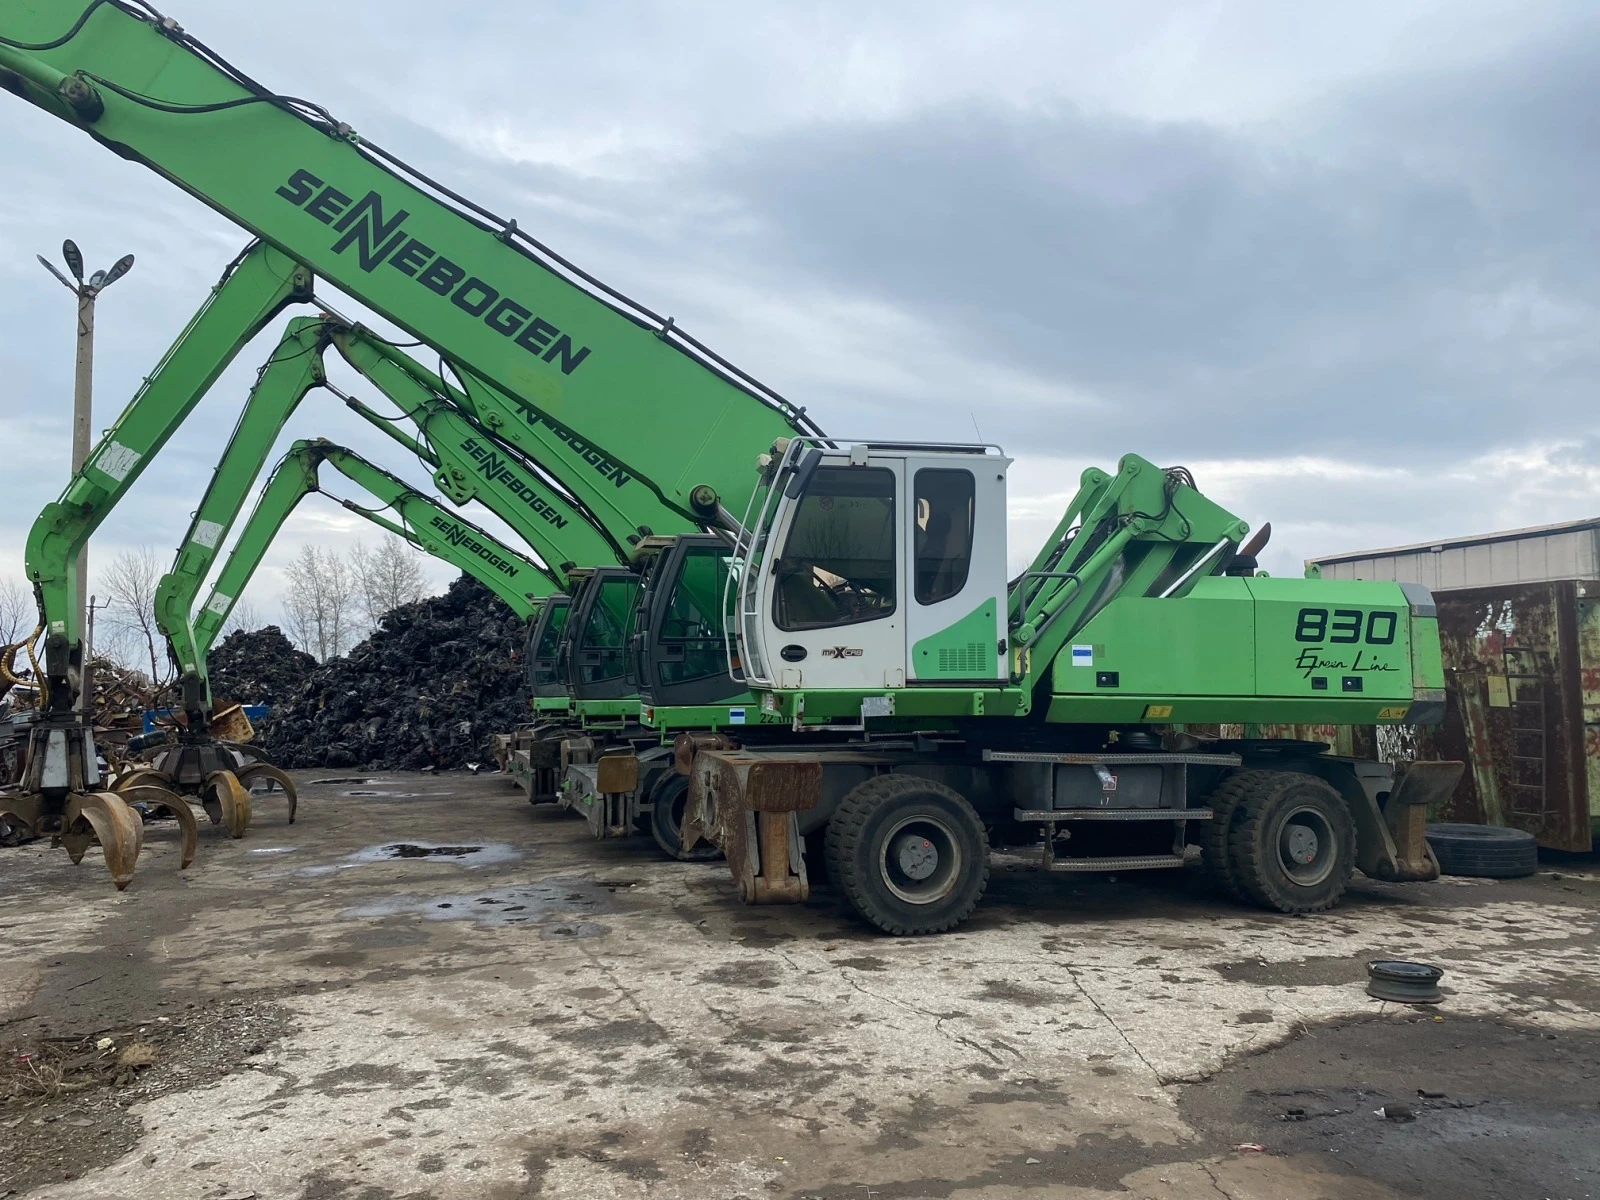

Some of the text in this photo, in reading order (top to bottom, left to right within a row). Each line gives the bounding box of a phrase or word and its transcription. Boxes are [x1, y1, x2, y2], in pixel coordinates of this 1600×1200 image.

[275, 168, 592, 376] SENNEBOGEN
[459, 437, 569, 530] SENNEBOGEN
[429, 516, 519, 578] SENNEBOGEN
[1295, 608, 1398, 645] 830
[1294, 647, 1400, 679] Green Line
[760, 713, 774, 724] 22
